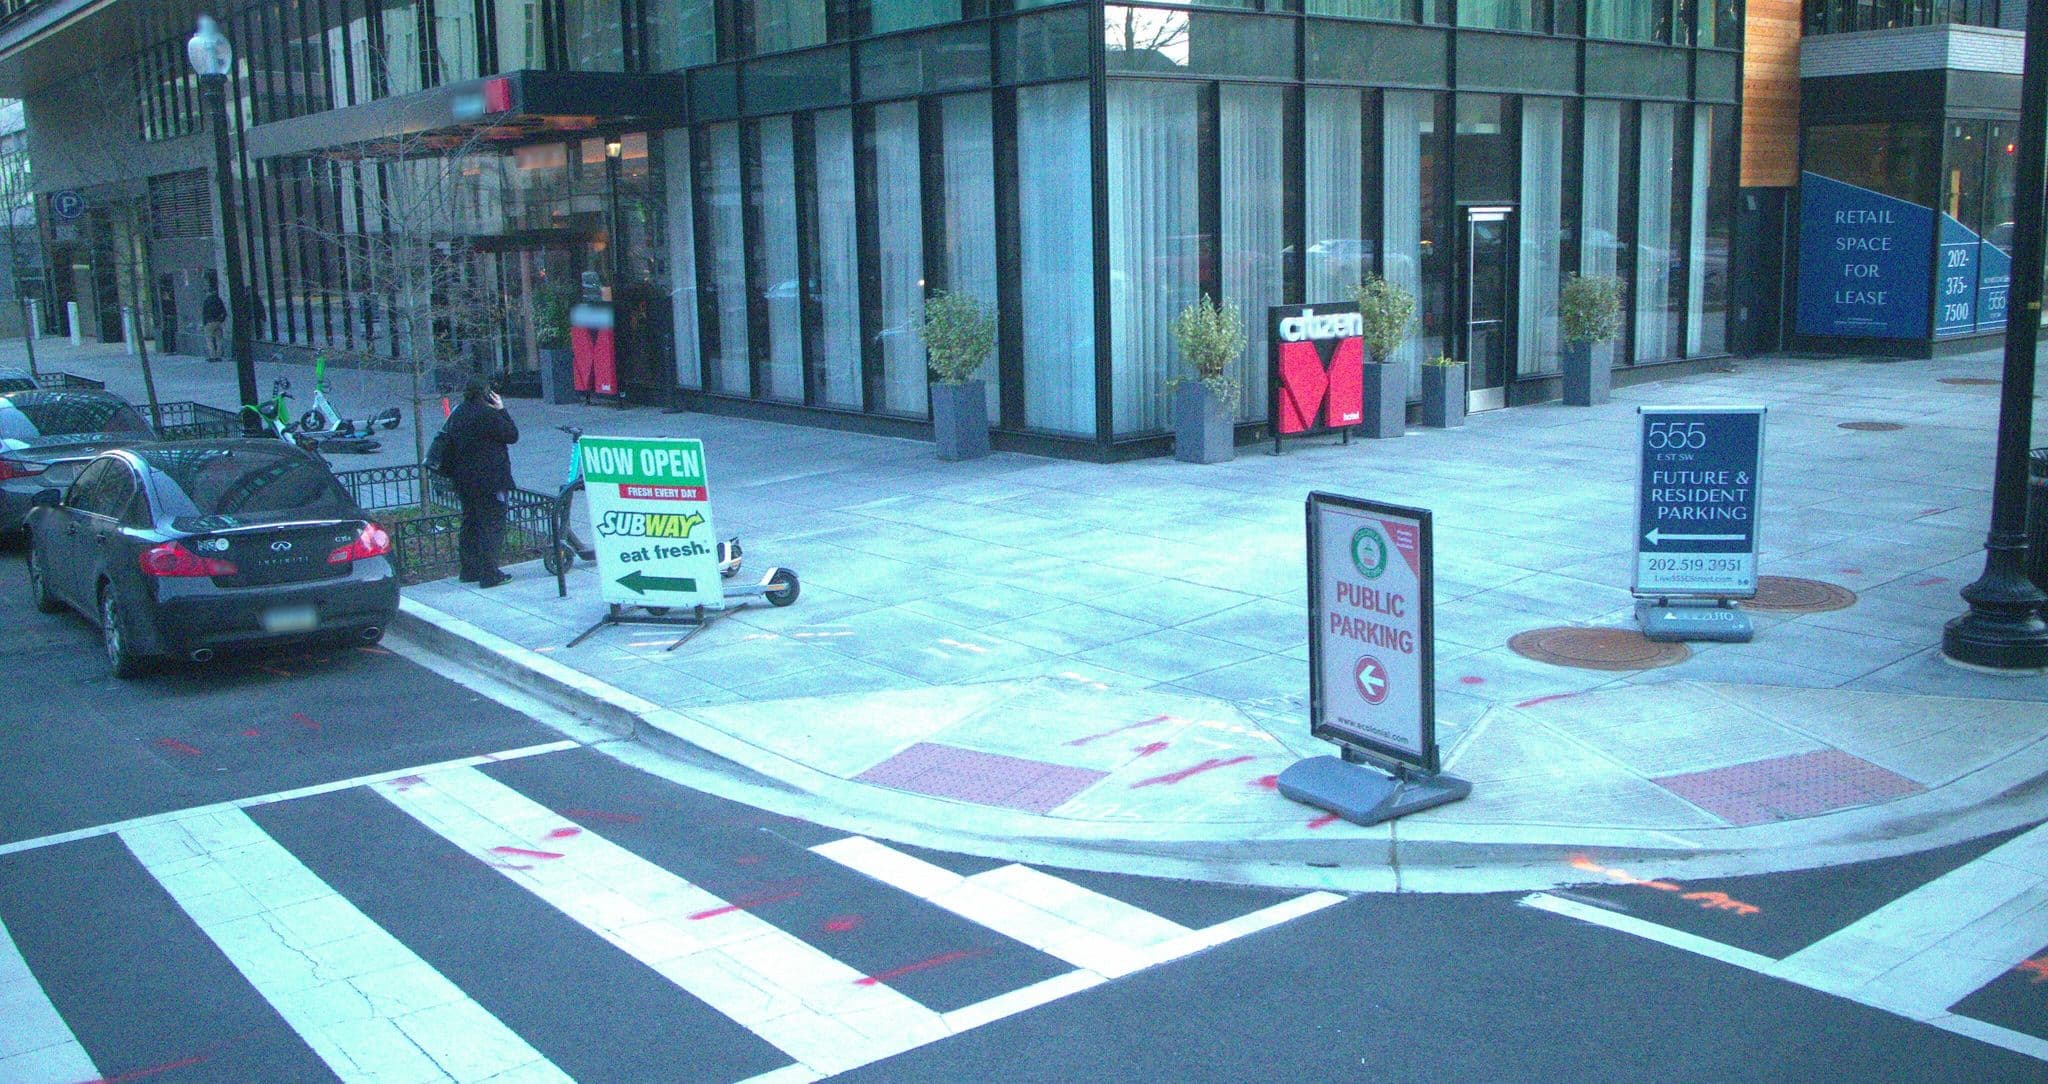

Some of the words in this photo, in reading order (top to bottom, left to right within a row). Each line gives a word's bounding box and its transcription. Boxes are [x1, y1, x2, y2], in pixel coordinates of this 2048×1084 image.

[1835, 210, 1896, 224] RETAIL
[1835, 237, 1892, 251] SPACE
[1947, 249, 1970, 268] 202-
[1845, 264, 1880, 278] FOR
[1945, 276, 1968, 296] 375-
[1834, 291, 1888, 305] LEASE
[1944, 302, 1969, 322] 7500
[1278, 336, 1364, 434] M
[1648, 422, 1706, 449] 555
[584, 446, 634, 476] NOW
[640, 448, 700, 478] OPEN
[1664, 453, 1678, 461] ST
[1680, 453, 1695, 461] SW
[1653, 471, 1729, 485] FUTURE
[1735, 471, 1750, 485] &
[627, 486, 653, 497] FRESH
[655, 487, 679, 498] EVERY
[681, 488, 697, 499] DAY
[1651, 488, 1749, 502] RESIDENT
[1658, 506, 1747, 520] PARKING
[597, 510, 705, 539] SUBWAY
[620, 550, 650, 563] eat
[1336, 580, 1405, 618] PUBLIC
[1330, 611, 1414, 655] PARKING
